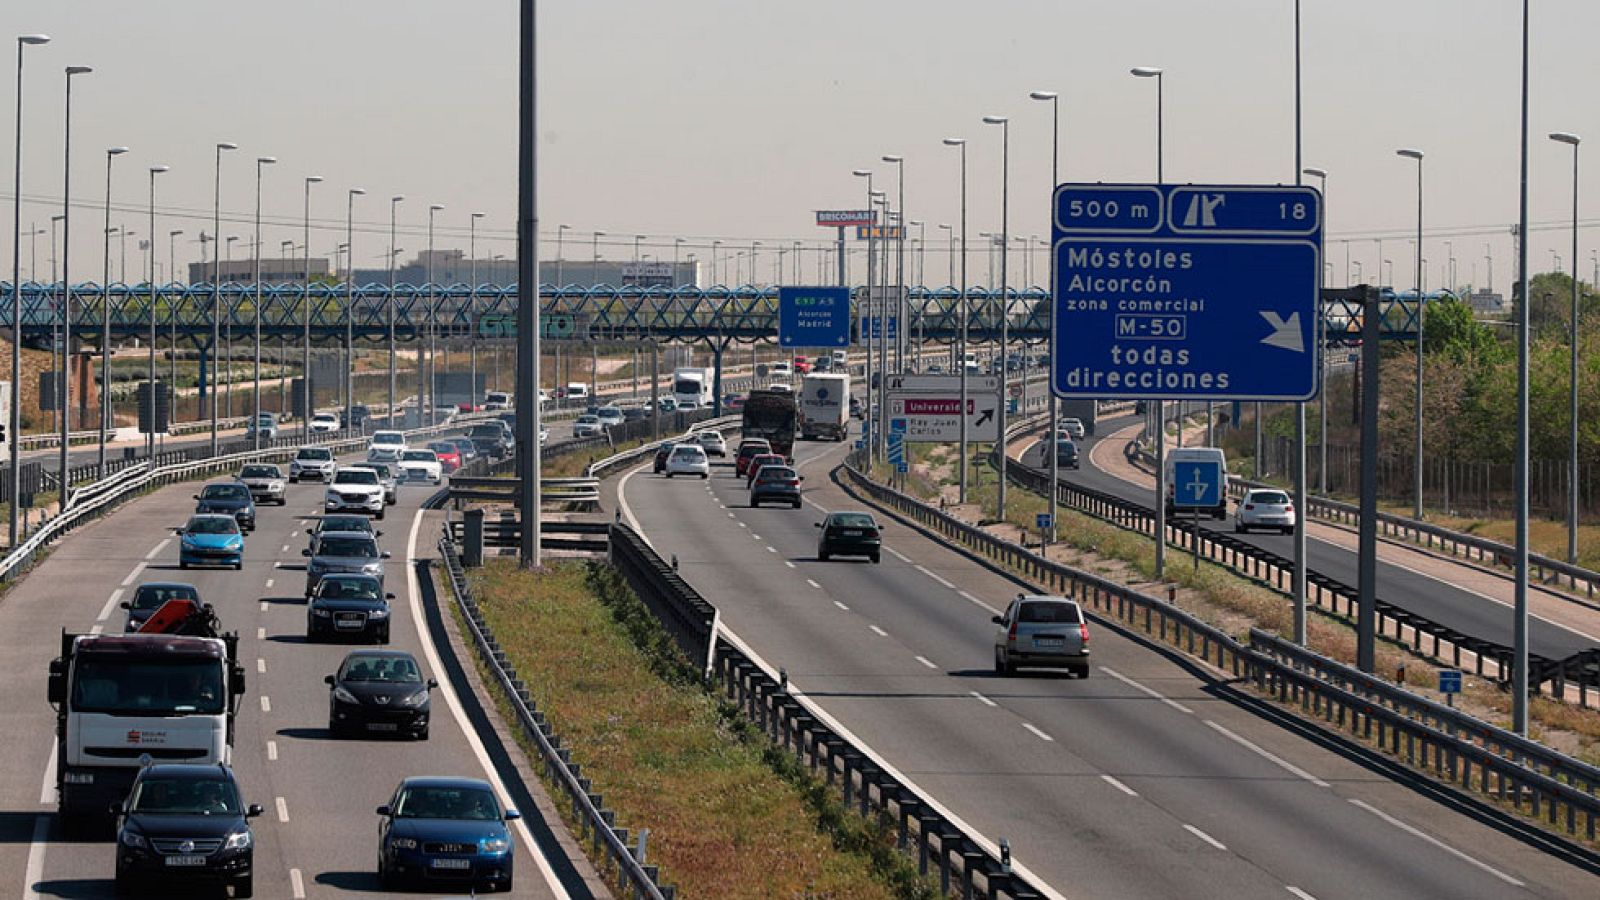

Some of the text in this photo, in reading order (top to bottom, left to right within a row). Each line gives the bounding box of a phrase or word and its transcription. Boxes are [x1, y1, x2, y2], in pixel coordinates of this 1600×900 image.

[1070, 200, 1148, 218] 500 m
[1279, 203, 1306, 220] 18
[1068, 247, 1193, 269] Móstoles
[1068, 274, 1171, 293] Alcorcón
[1067, 298, 1204, 311] zona comercial
[1119, 318, 1181, 336] M-50
[1111, 345, 1190, 365] todas
[1067, 367, 1229, 389] direcciones
[910, 401, 973, 412] Universidd
